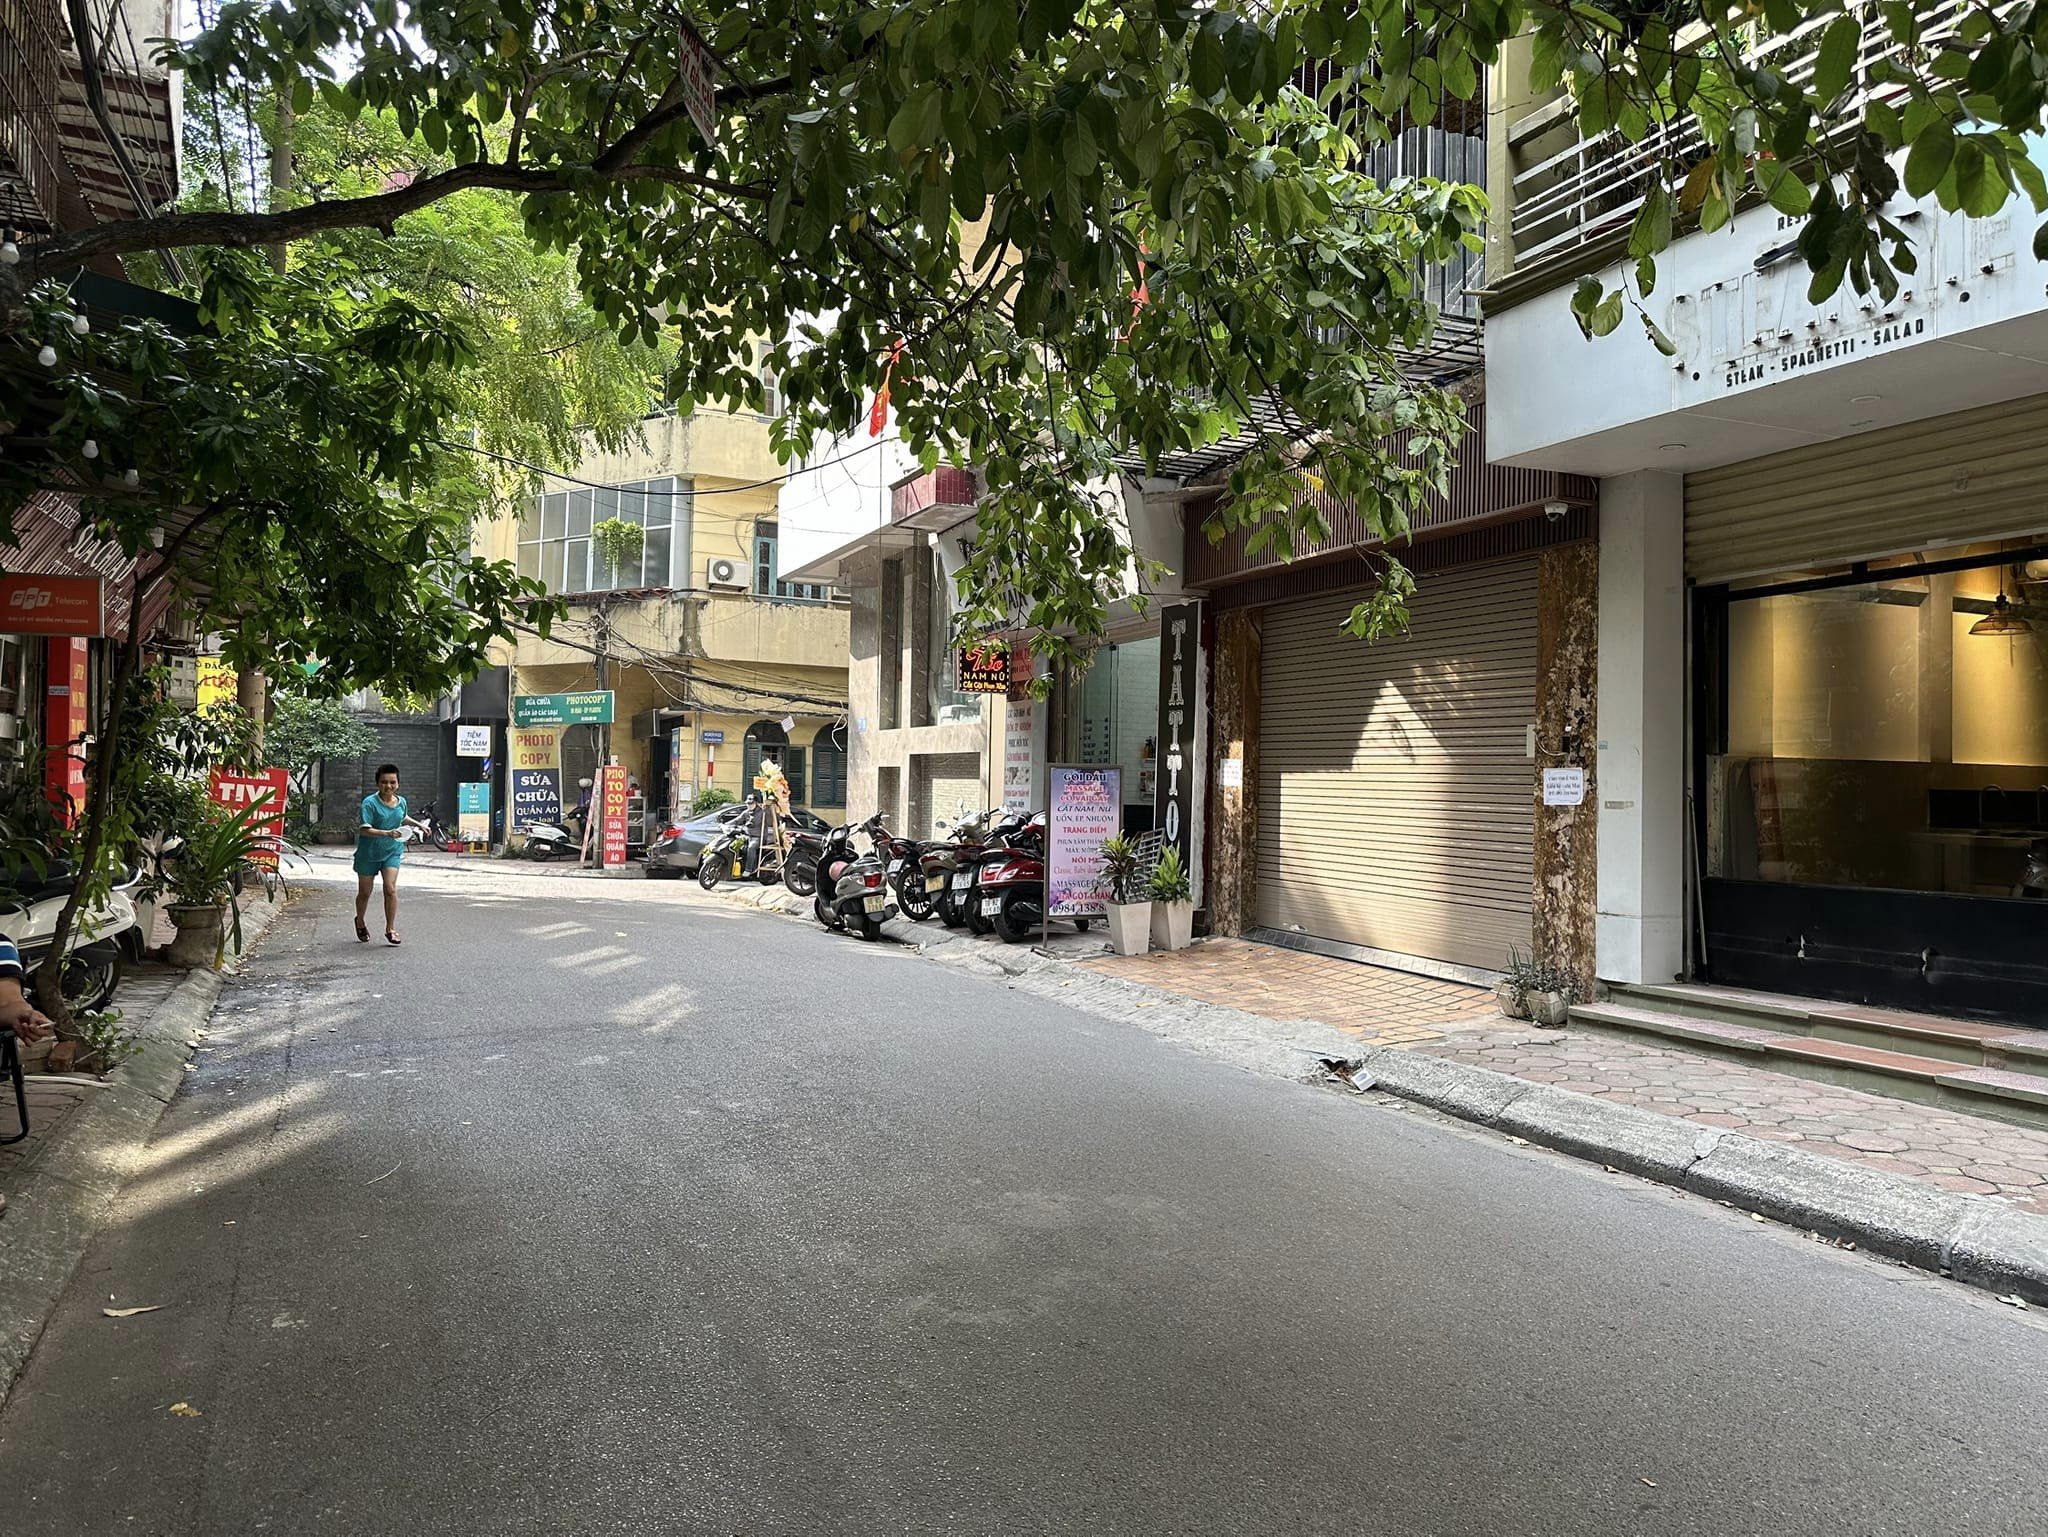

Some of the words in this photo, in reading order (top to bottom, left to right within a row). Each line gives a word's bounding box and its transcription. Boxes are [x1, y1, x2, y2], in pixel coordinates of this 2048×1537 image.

[1726, 364, 1764, 388] STEAK
[1782, 338, 1855, 372] SPAGHETTI
[1873, 318, 1924, 346] SALAD
[11, 590, 50, 606] FPT
[55, 596, 89, 606] Telecom
[963, 671, 987, 681] NAM
[566, 694, 607, 705] PHOTOCOPY
[1165, 618, 1186, 848] TATTO
[473, 739, 488, 747] NAM
[516, 734, 554, 747] PHOTO
[520, 753, 551, 765] COPY
[520, 772, 552, 786] SỬA
[606, 768, 625, 779] PHO
[608, 782, 624, 791] TO
[1064, 784, 1104, 793] MASSAGE
[515, 789, 558, 802] CHỮA
[607, 794, 623, 803] CO
[607, 806, 622, 816] PY
[1063, 826, 1088, 834] TRANG
[1057, 879, 1091, 888] MASSAGE
